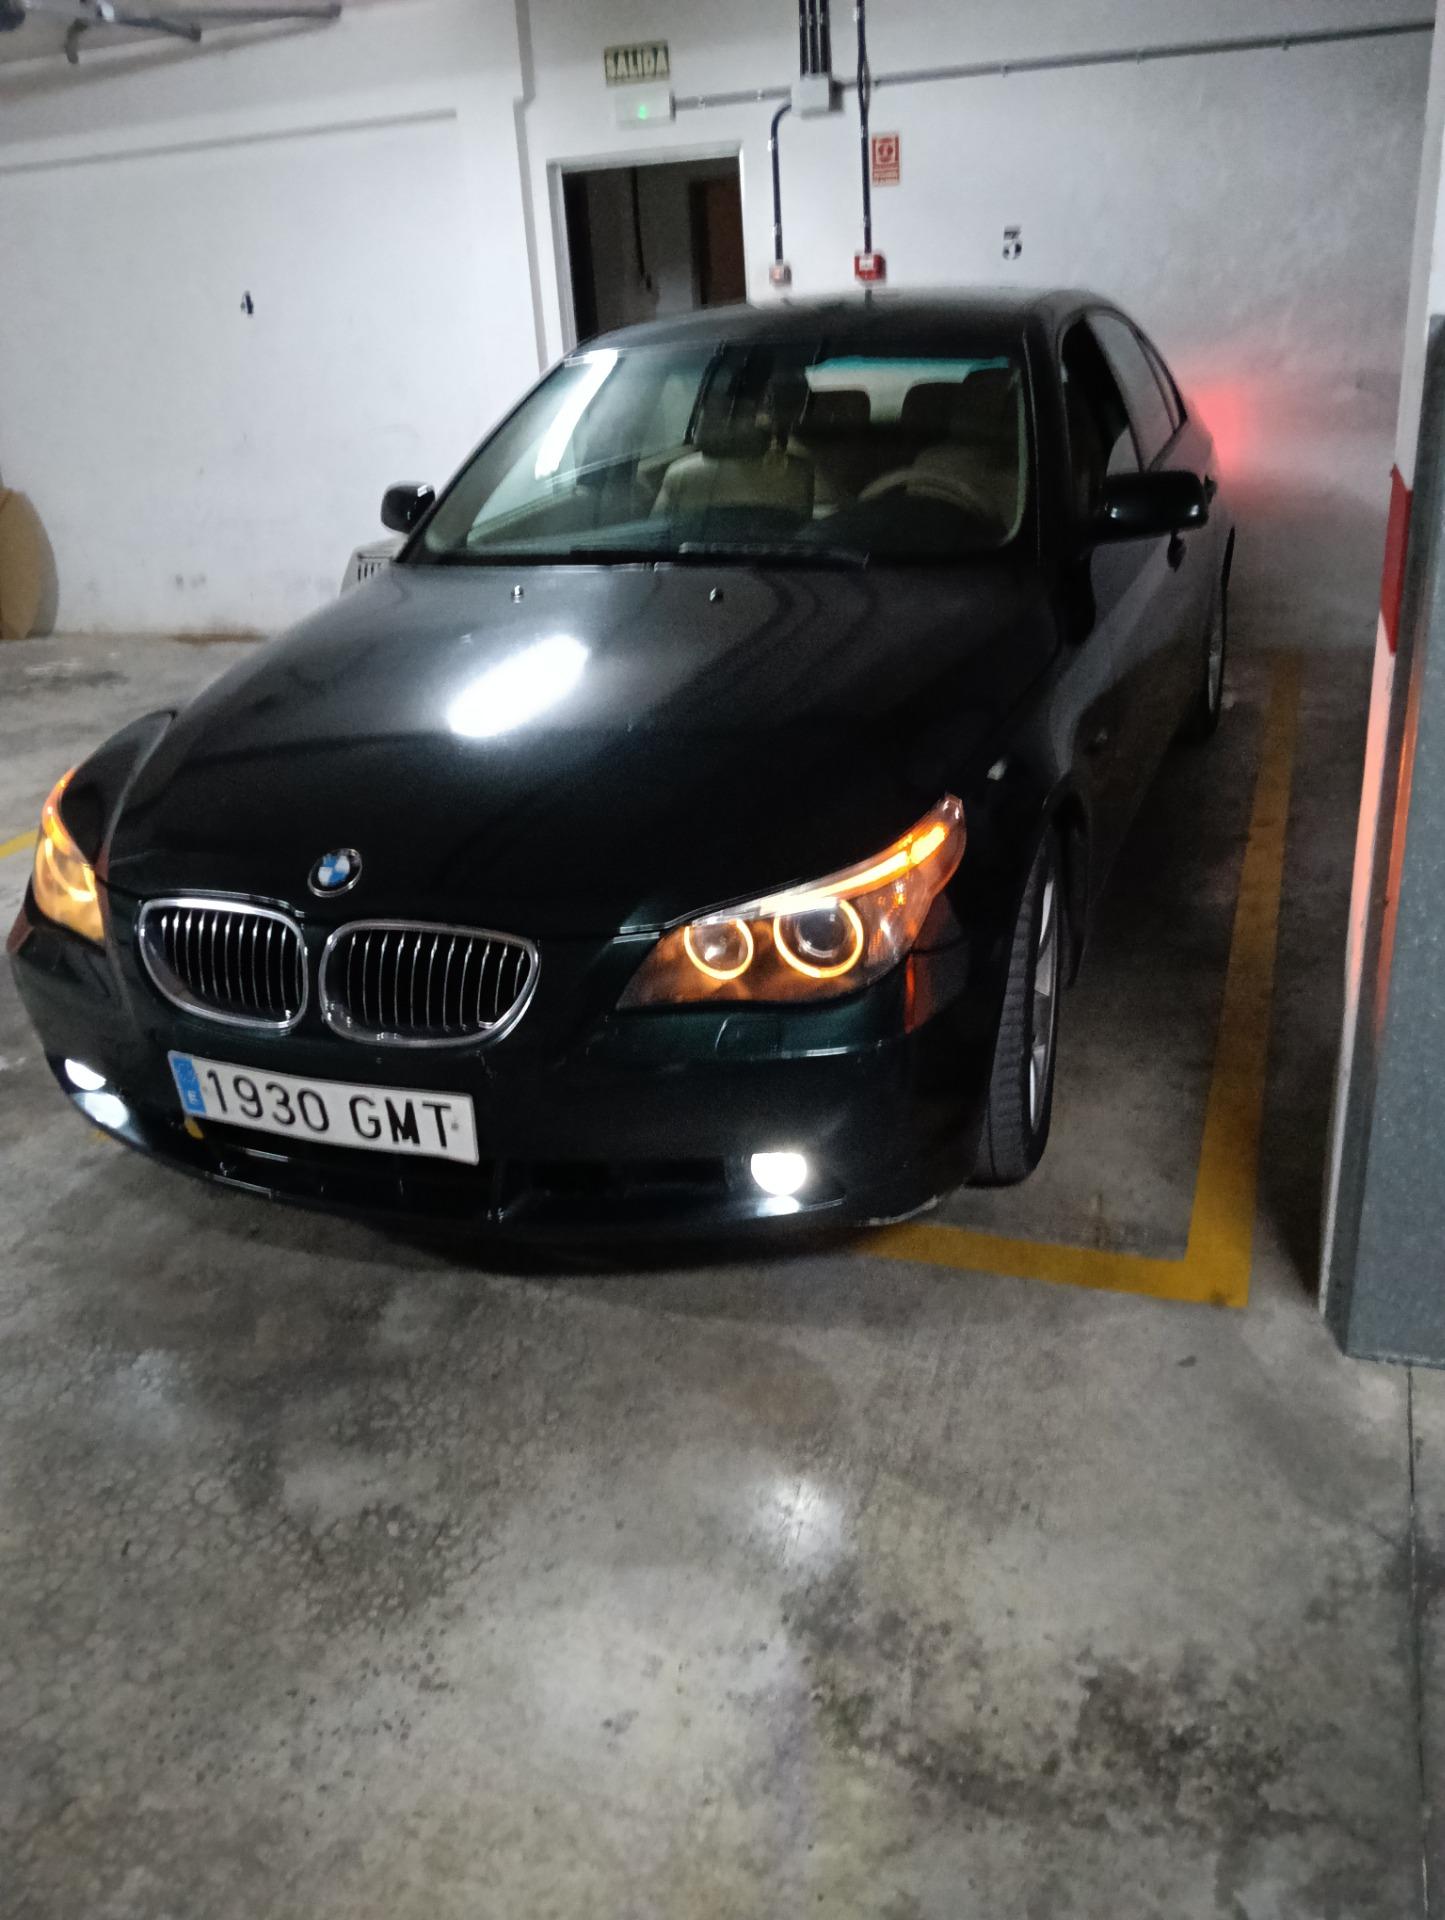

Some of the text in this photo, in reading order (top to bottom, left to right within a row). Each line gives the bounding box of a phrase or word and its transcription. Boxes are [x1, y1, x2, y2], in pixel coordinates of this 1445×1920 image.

[605, 45, 669, 80] SALIDA
[207, 1068, 451, 1150] 1930 GMT
